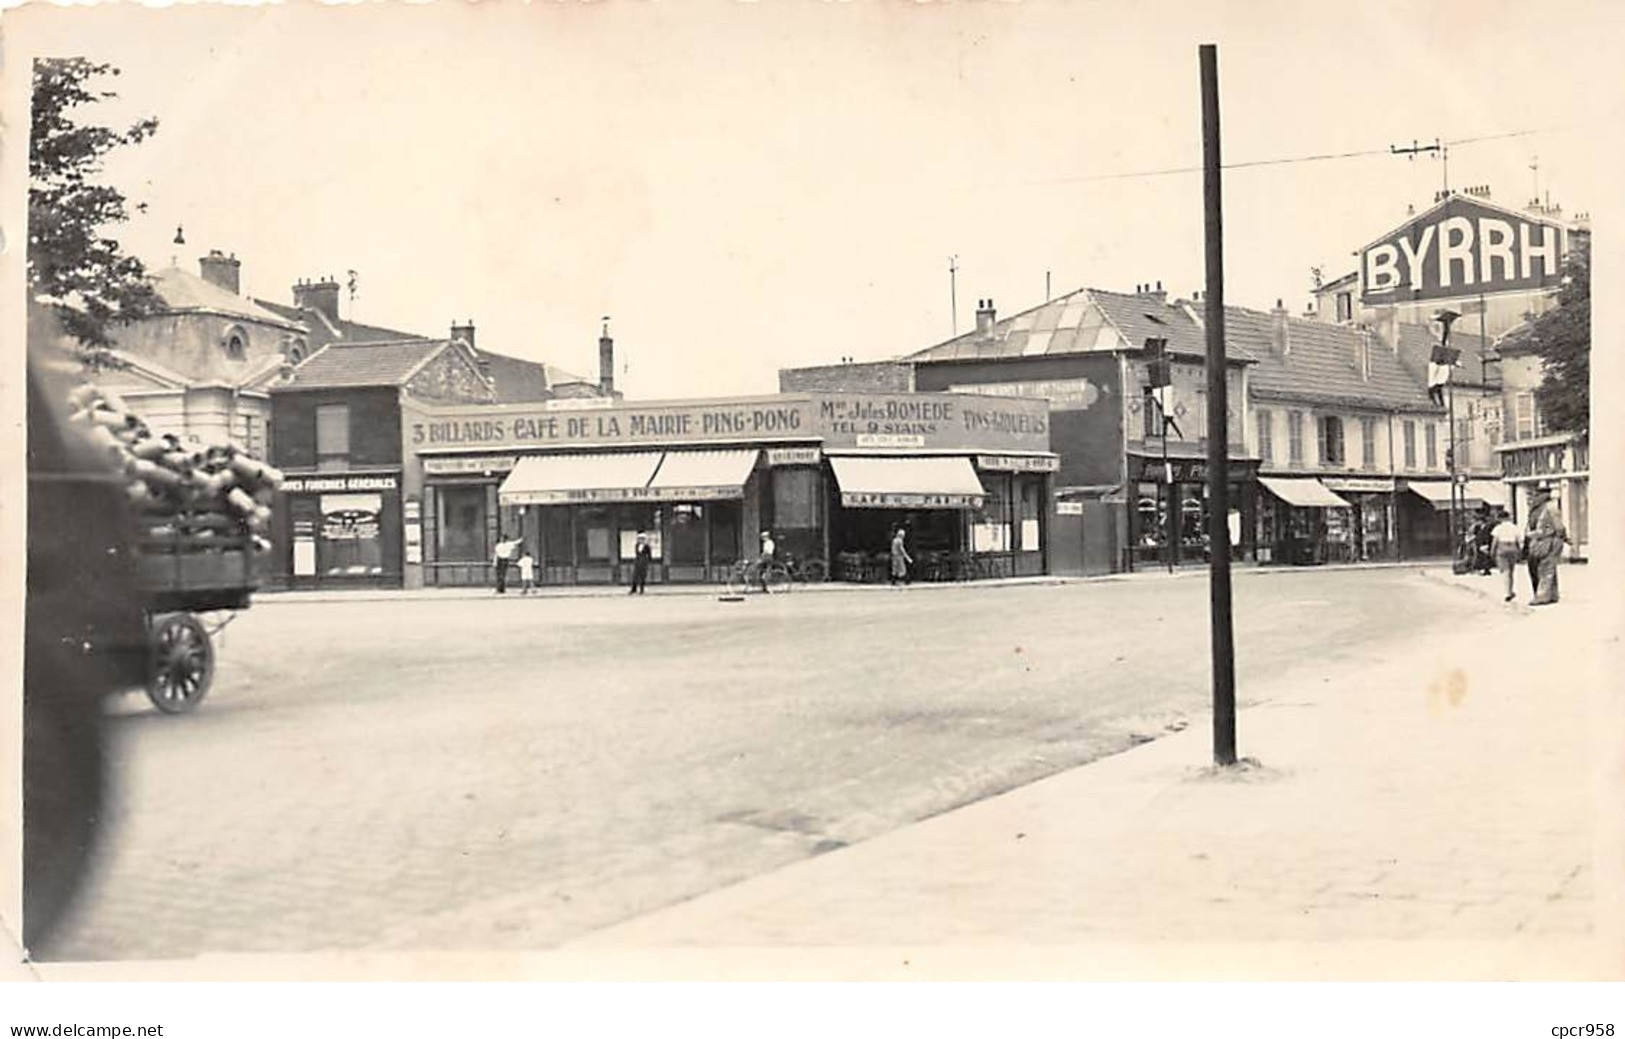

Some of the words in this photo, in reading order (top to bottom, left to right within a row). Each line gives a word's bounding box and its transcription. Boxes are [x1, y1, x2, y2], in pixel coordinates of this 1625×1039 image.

[1366, 216, 1556, 293] BYRRH
[412, 423, 425, 443] 3
[429, 420, 504, 442] BILLARDS
[513, 416, 559, 439] CAFÉ
[567, 416, 590, 437] DE
[598, 415, 620, 437] LA
[629, 414, 691, 436] MAIRIE
[884, 423, 936, 434] STAINS
